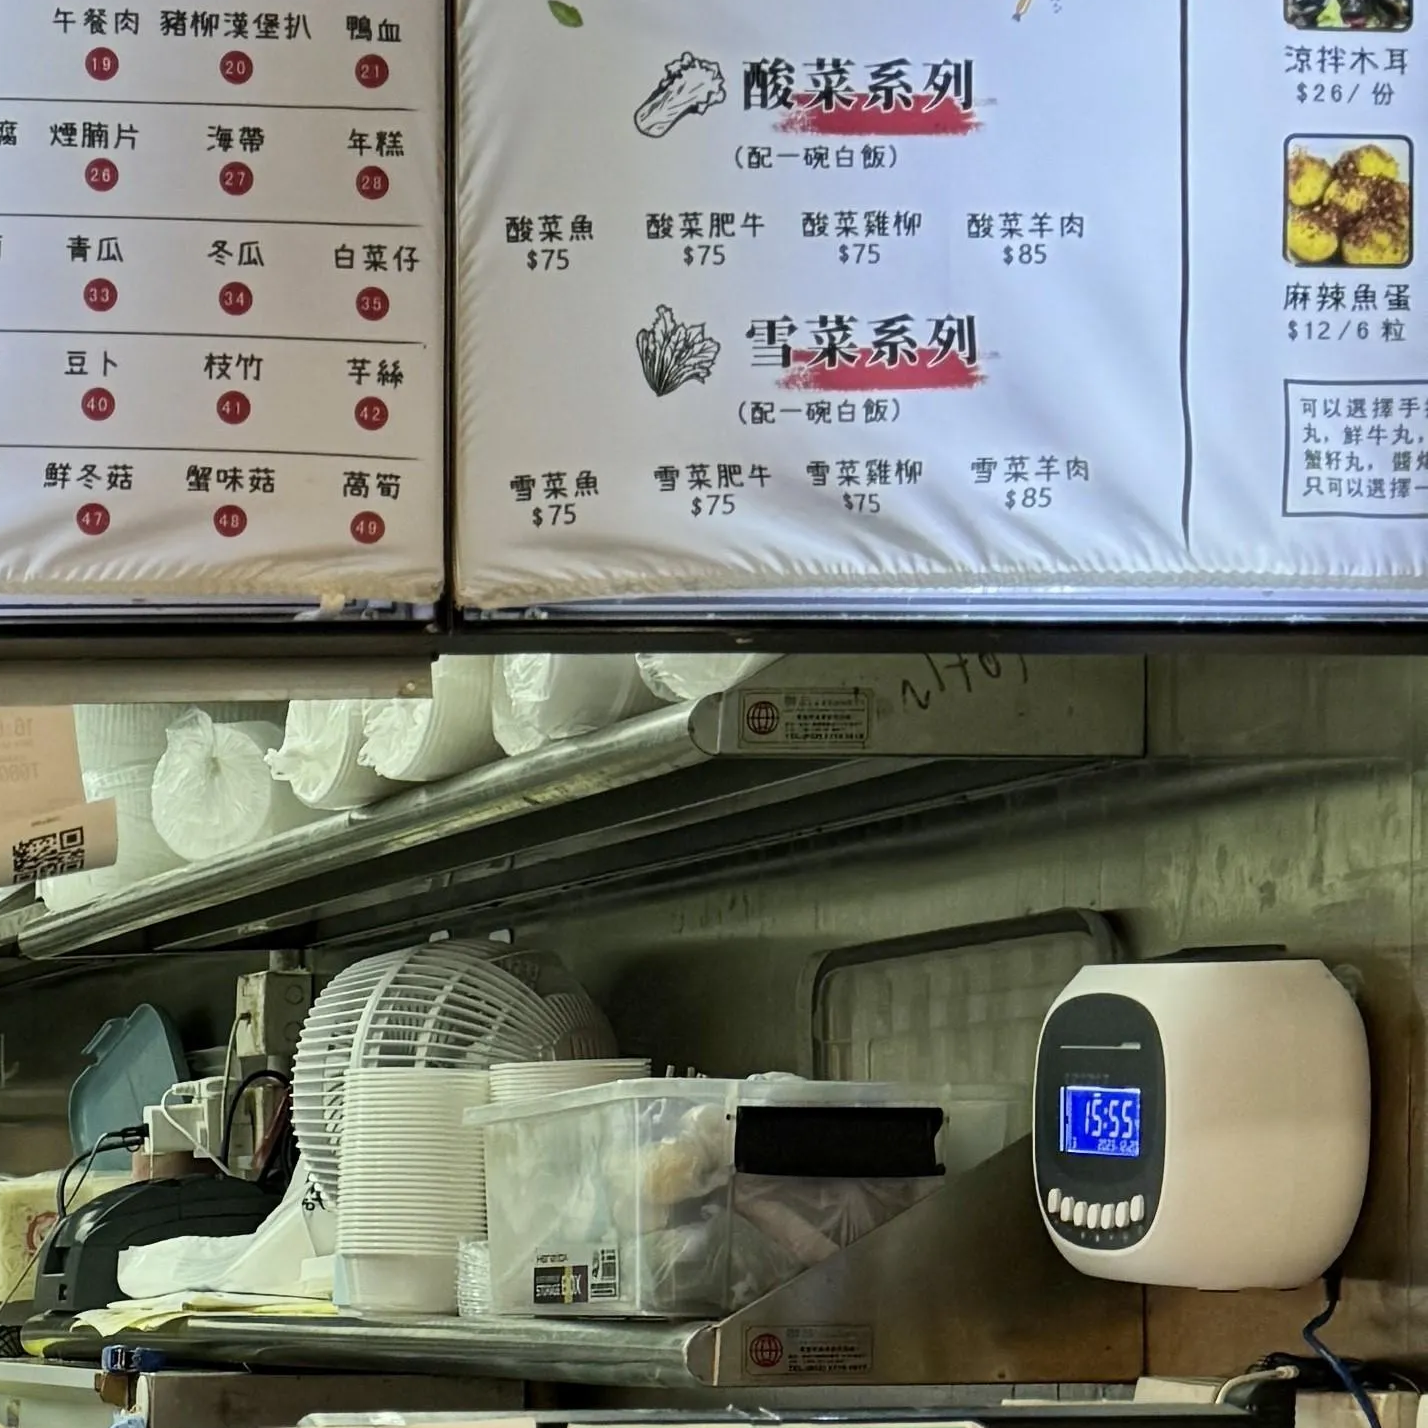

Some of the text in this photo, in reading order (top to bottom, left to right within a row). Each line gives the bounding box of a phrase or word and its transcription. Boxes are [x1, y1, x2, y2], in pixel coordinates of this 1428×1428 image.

[1284, 45, 1409, 76] 涼拌木耳
[742, 57, 975, 114] 酸菜系列
[206, 125, 265, 154] 海帶
[347, 128, 405, 158] 年糕
[505, 211, 765, 244] 酸菜魚 酸菜肥牛
[66, 234, 124, 263] 青瓜
[207, 239, 265, 267] 冬瓜
[1283, 281, 1411, 312] 麻辣魚蛋
[745, 313, 979, 370] 雪菜系列
